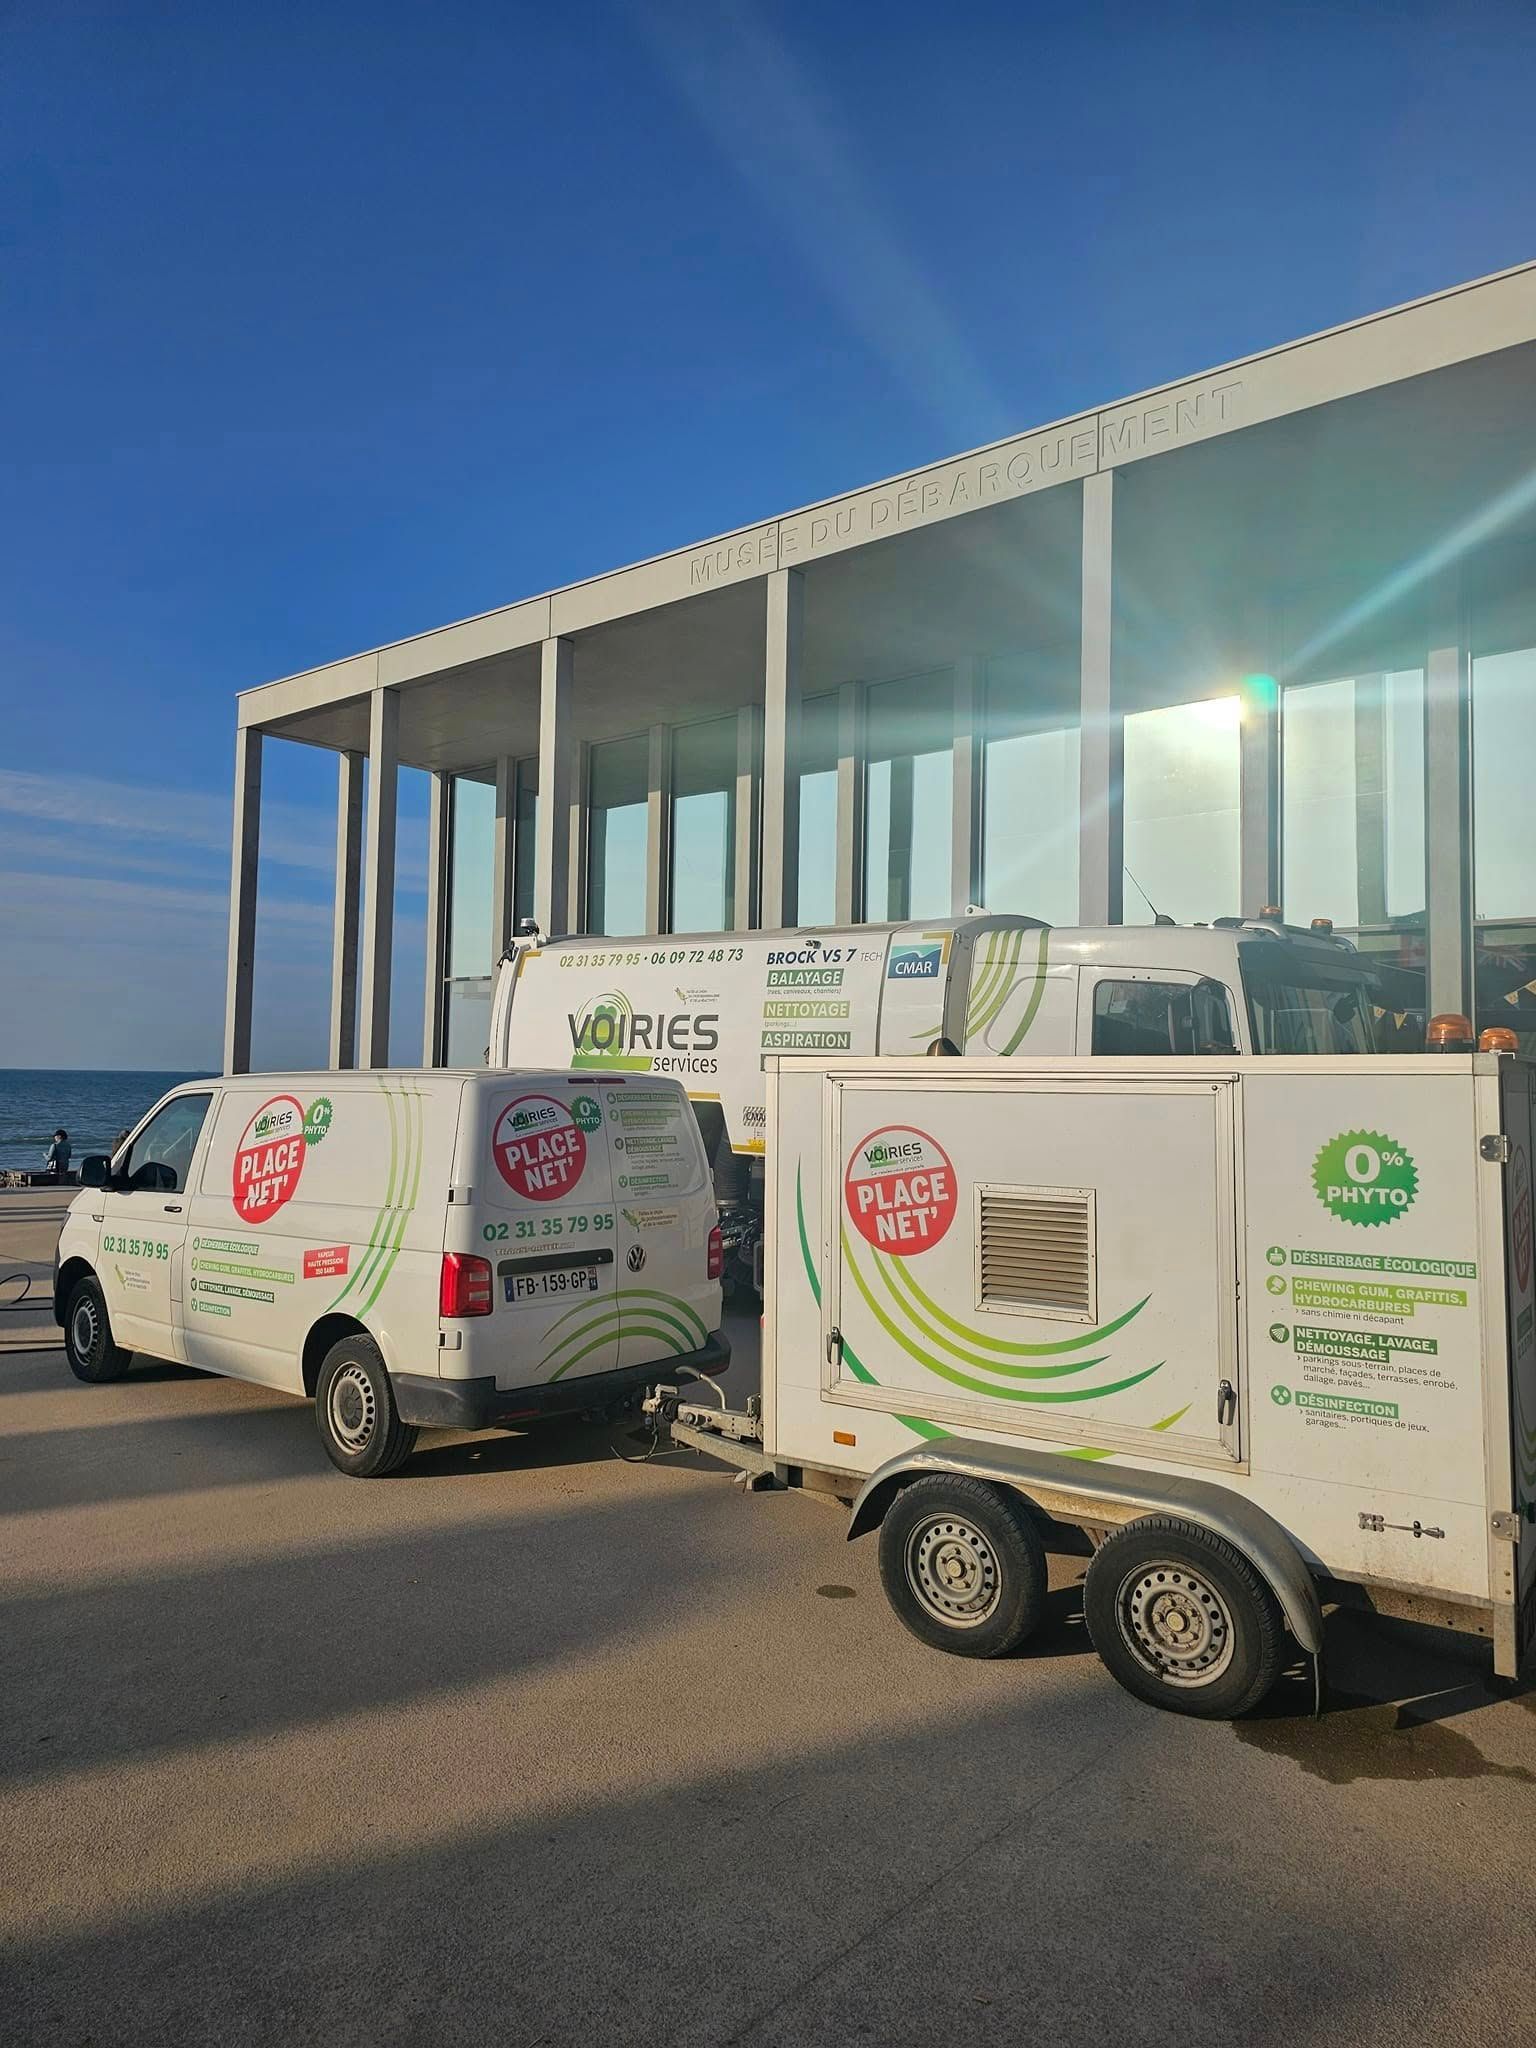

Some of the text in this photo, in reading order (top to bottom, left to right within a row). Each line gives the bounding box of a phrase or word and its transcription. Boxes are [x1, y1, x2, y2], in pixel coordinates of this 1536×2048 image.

[690, 381, 1243, 587] MUSÉE DU DÉBARQUEMENT
[559, 948, 743, 968] 02 31 35 79 95 06 09 72 48 73
[766, 948, 882, 965] BROCK VS 7 TECH
[769, 970, 841, 985] BALAYAGE
[895, 961, 932, 975] CMAR
[766, 1003, 848, 1017] NETTOYAGE
[567, 1014, 720, 1051] VOIRIES
[763, 1032, 849, 1048] ASPIRATION
[653, 1053, 718, 1073] services
[255, 1111, 293, 1133] VOIRIES
[507, 1107, 556, 1127] VOIRIES
[576, 1116, 600, 1125] PHYTO
[304, 1125, 328, 1135] PHYTO
[504, 1128, 581, 1170] PLACE
[864, 1142, 922, 1162] VOIRIES
[240, 1139, 301, 1184] PLACE
[524, 1156, 574, 1193] NET'
[857, 1172, 949, 1214] PLACE
[1327, 1185, 1408, 1206] PHYTO
[483, 1213, 614, 1241] 02 31 35 79 95
[875, 1206, 938, 1242] NET'
[103, 1236, 169, 1260] 02 31 35 79 95
[1293, 1250, 1475, 1278] DÉSHERBAGE ÉCOLOGIQUE
[516, 1270, 587, 1297] FB-159-GP
[1294, 1279, 1355, 1295] CHEWING
[1295, 1294, 1411, 1313] HYDROCARBURES
[1301, 1308, 1321, 1317] sans
[1322, 1309, 1351, 1320] chimie
[1363, 1313, 1405, 1325] décapant
[1296, 1327, 1435, 1353] NETTOYAGE, LAVAGE,
[1297, 1341, 1387, 1361] DÉMOUSSAGE
[1303, 1355, 1442, 1378] parkings sous-terrain, places de
[1303, 1364, 1458, 1391] marché, façades, terrasses, enrobé,
[1299, 1394, 1395, 1417] DÉSINFECTION
[1305, 1408, 1349, 1422] sanitaires,
[1350, 1415, 1393, 1428] portiques
[1394, 1420, 1407, 1430] de
